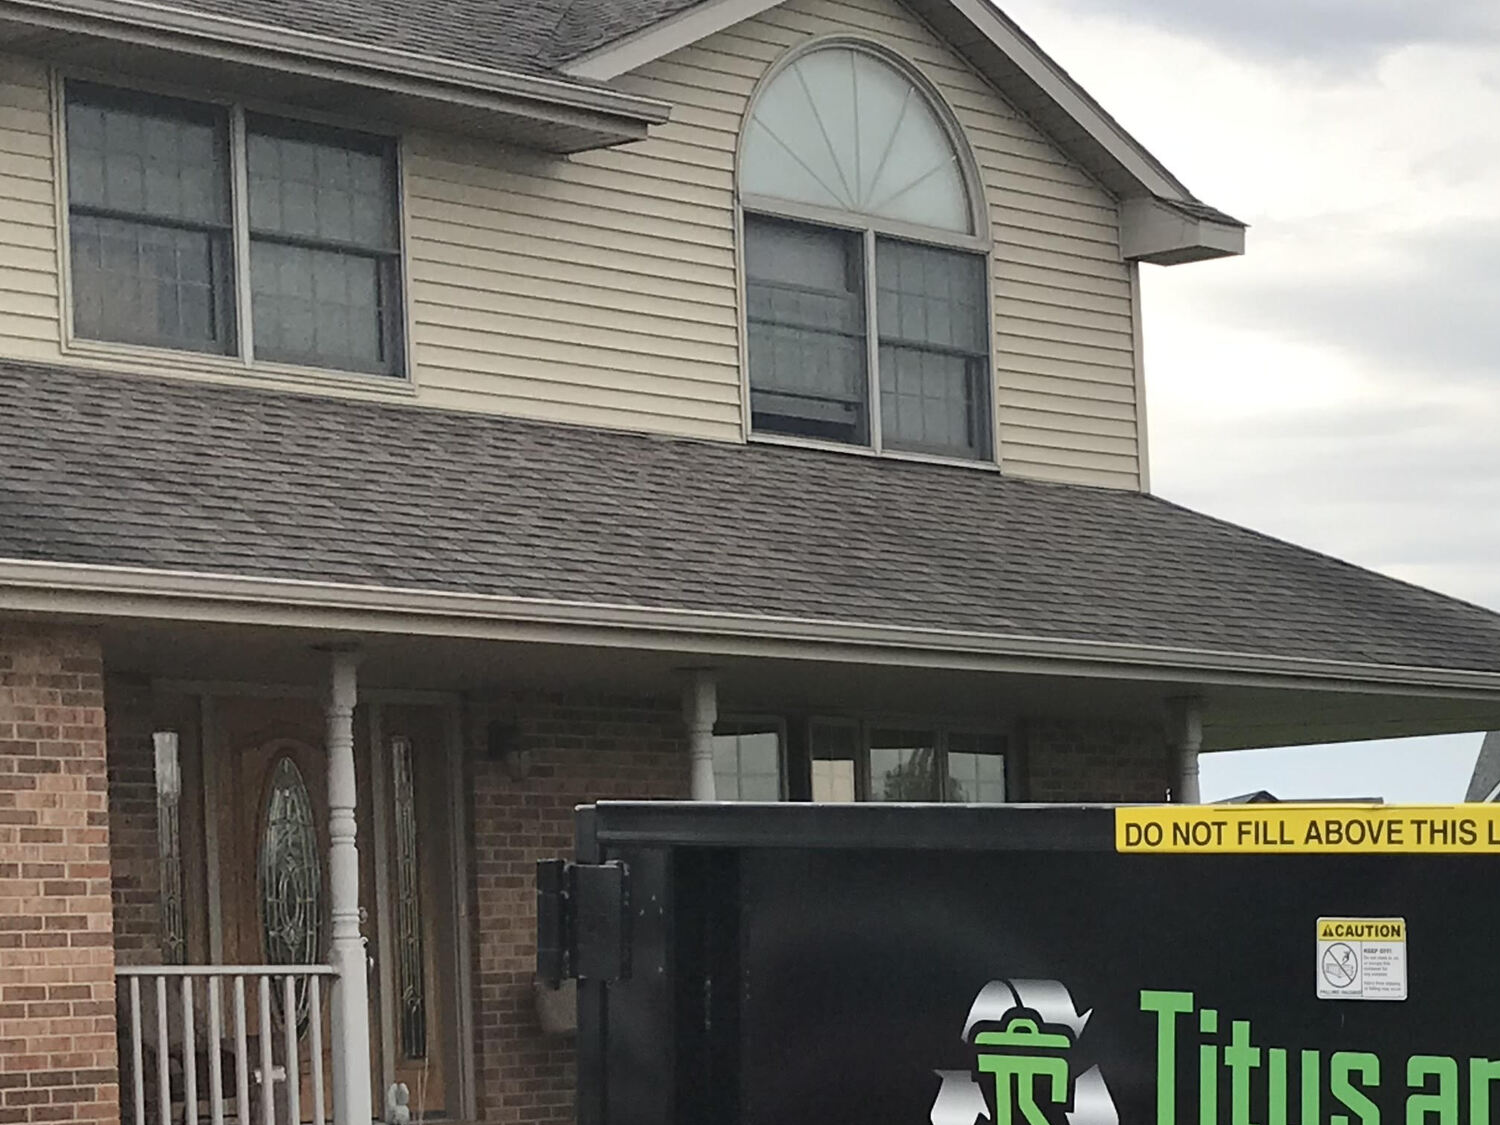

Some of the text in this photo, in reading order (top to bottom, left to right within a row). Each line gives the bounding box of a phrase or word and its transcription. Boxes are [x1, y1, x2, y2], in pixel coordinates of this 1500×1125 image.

[1125, 821, 1163, 847] DO
[1172, 821, 1228, 846] NOT
[1237, 820, 1295, 845] FILL
[1303, 819, 1404, 845] ABOVE
[1410, 819, 1477, 845] THIS
[1334, 924, 1401, 938] CAUTION
